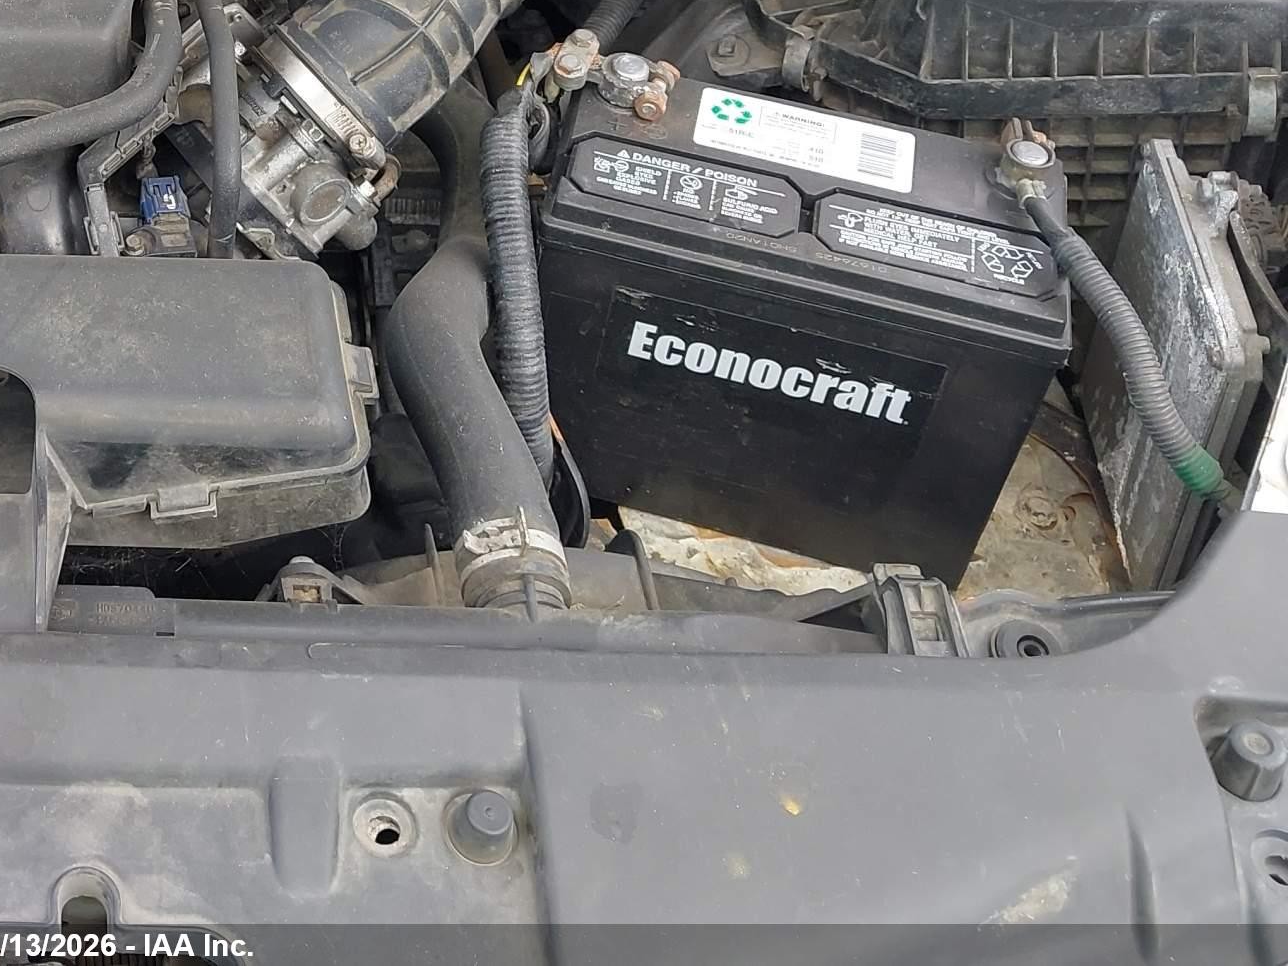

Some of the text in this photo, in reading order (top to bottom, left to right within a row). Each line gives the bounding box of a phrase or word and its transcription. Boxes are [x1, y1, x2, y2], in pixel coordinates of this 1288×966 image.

[632, 152, 692, 173] DANGER
[704, 169, 759, 188] POISON
[635, 166, 663, 177] SHIELD
[863, 226, 896, 239] MEDICAL
[864, 215, 960, 243] FLUSH EYES IMMEDIATELY
[626, 320, 914, 426] Econocraft
